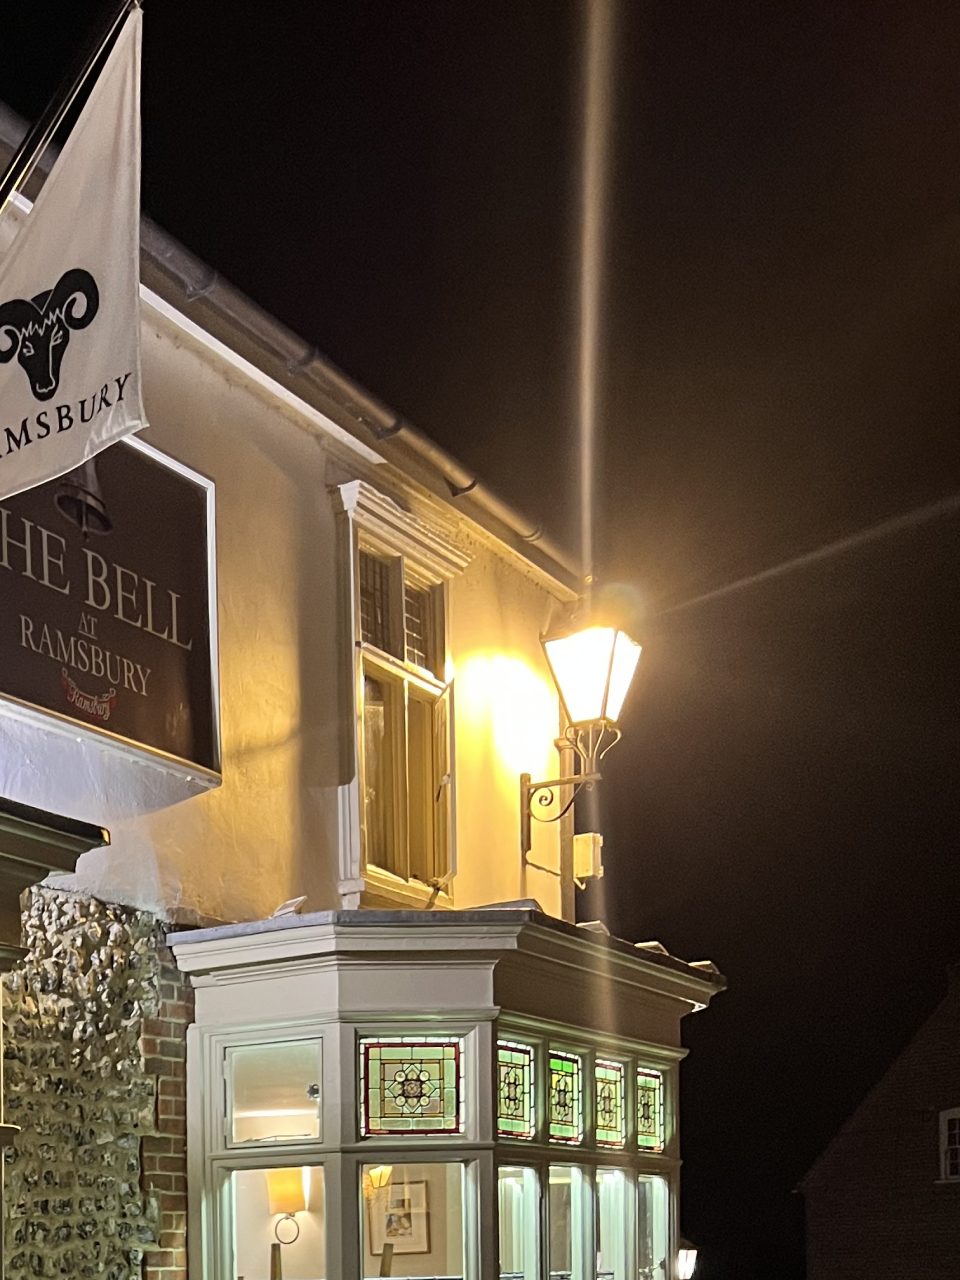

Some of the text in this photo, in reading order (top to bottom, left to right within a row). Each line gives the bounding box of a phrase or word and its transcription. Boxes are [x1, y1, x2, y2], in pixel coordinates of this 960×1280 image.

[78, 611, 98, 636] AT
[81, 547, 192, 650] BELL
[19, 614, 152, 696] RAMSBURY
